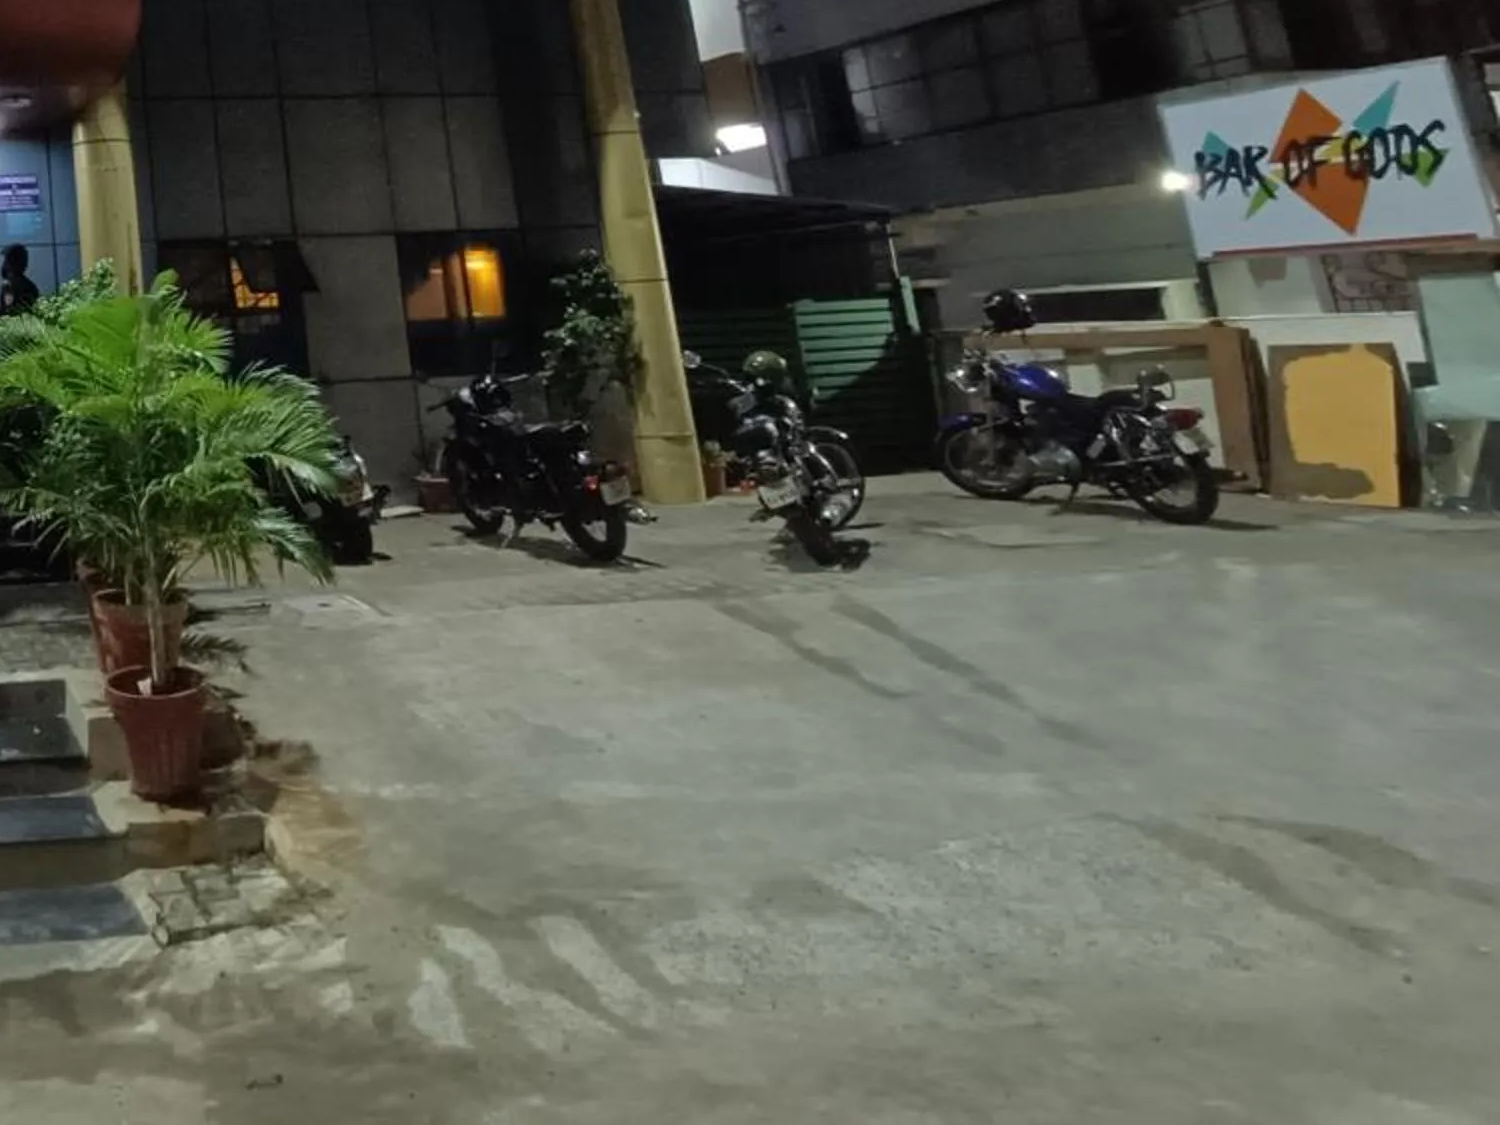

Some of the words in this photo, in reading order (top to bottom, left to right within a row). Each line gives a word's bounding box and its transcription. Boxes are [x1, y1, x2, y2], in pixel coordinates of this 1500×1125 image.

[1194, 145, 1278, 201] BAR
[1283, 135, 1342, 189] OF
[1340, 119, 1446, 181] GODS
